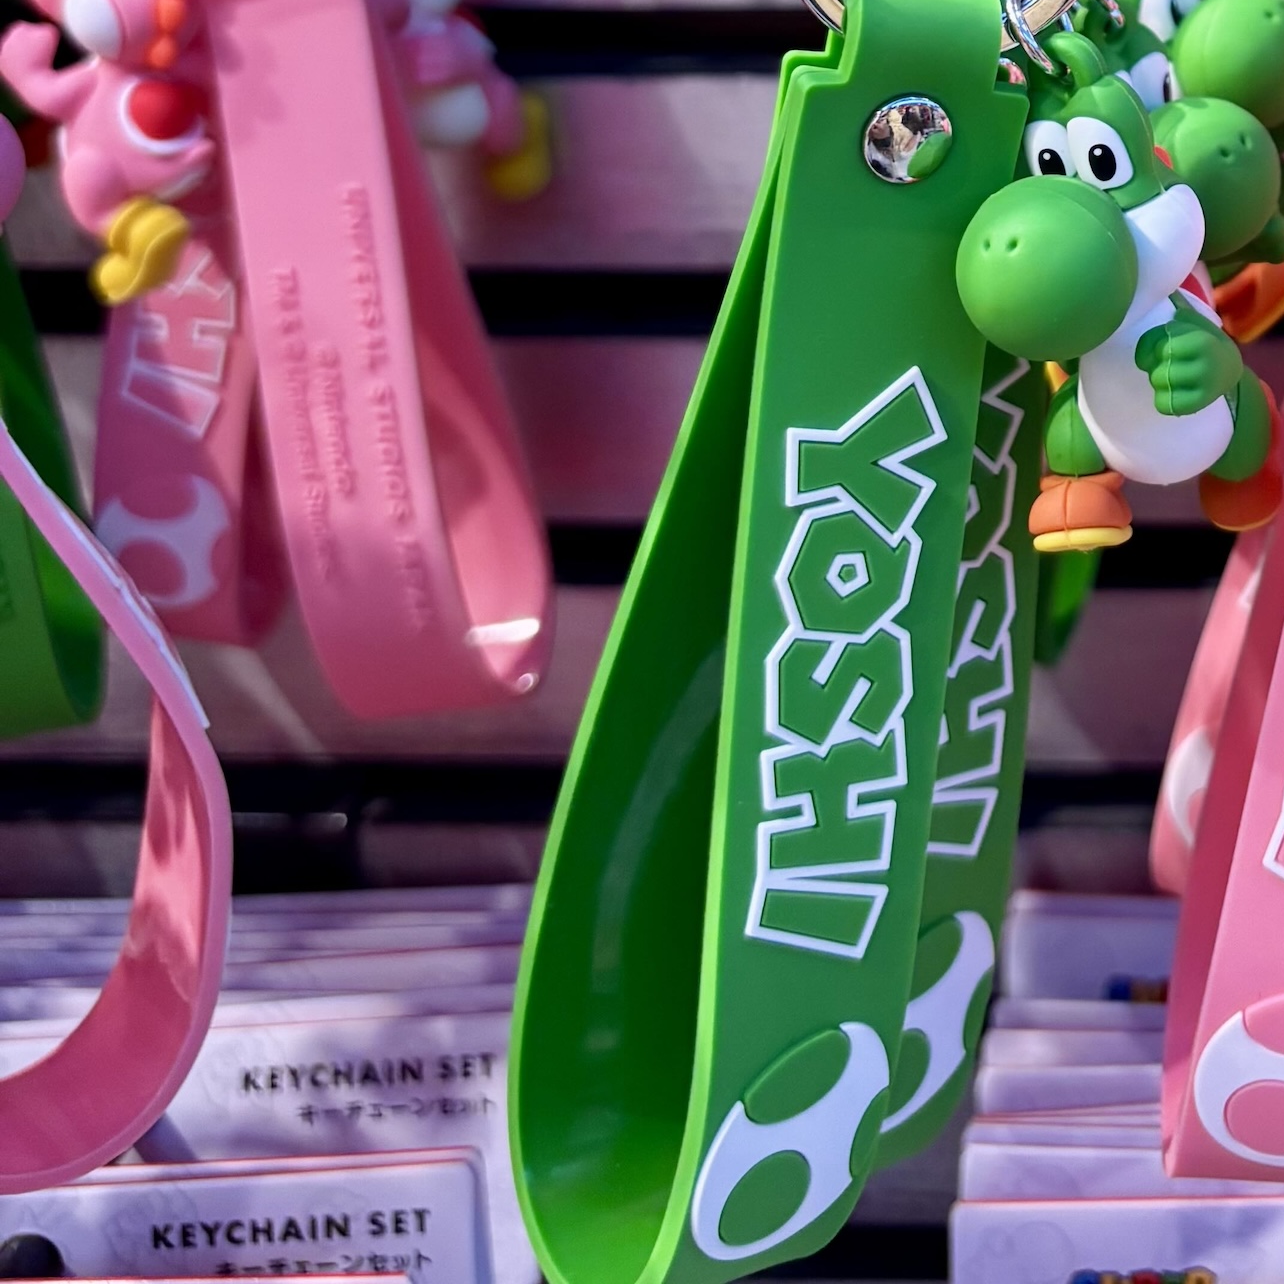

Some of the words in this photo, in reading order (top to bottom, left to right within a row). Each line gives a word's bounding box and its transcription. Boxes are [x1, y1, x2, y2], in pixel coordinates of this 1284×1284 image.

[744, 365, 948, 960] YOSHI
[242, 1055, 423, 1093] KEYCHAIN
[438, 1051, 496, 1080] SET
[151, 1215, 350, 1250] KEYCHAIN
[367, 1208, 430, 1237] SET
